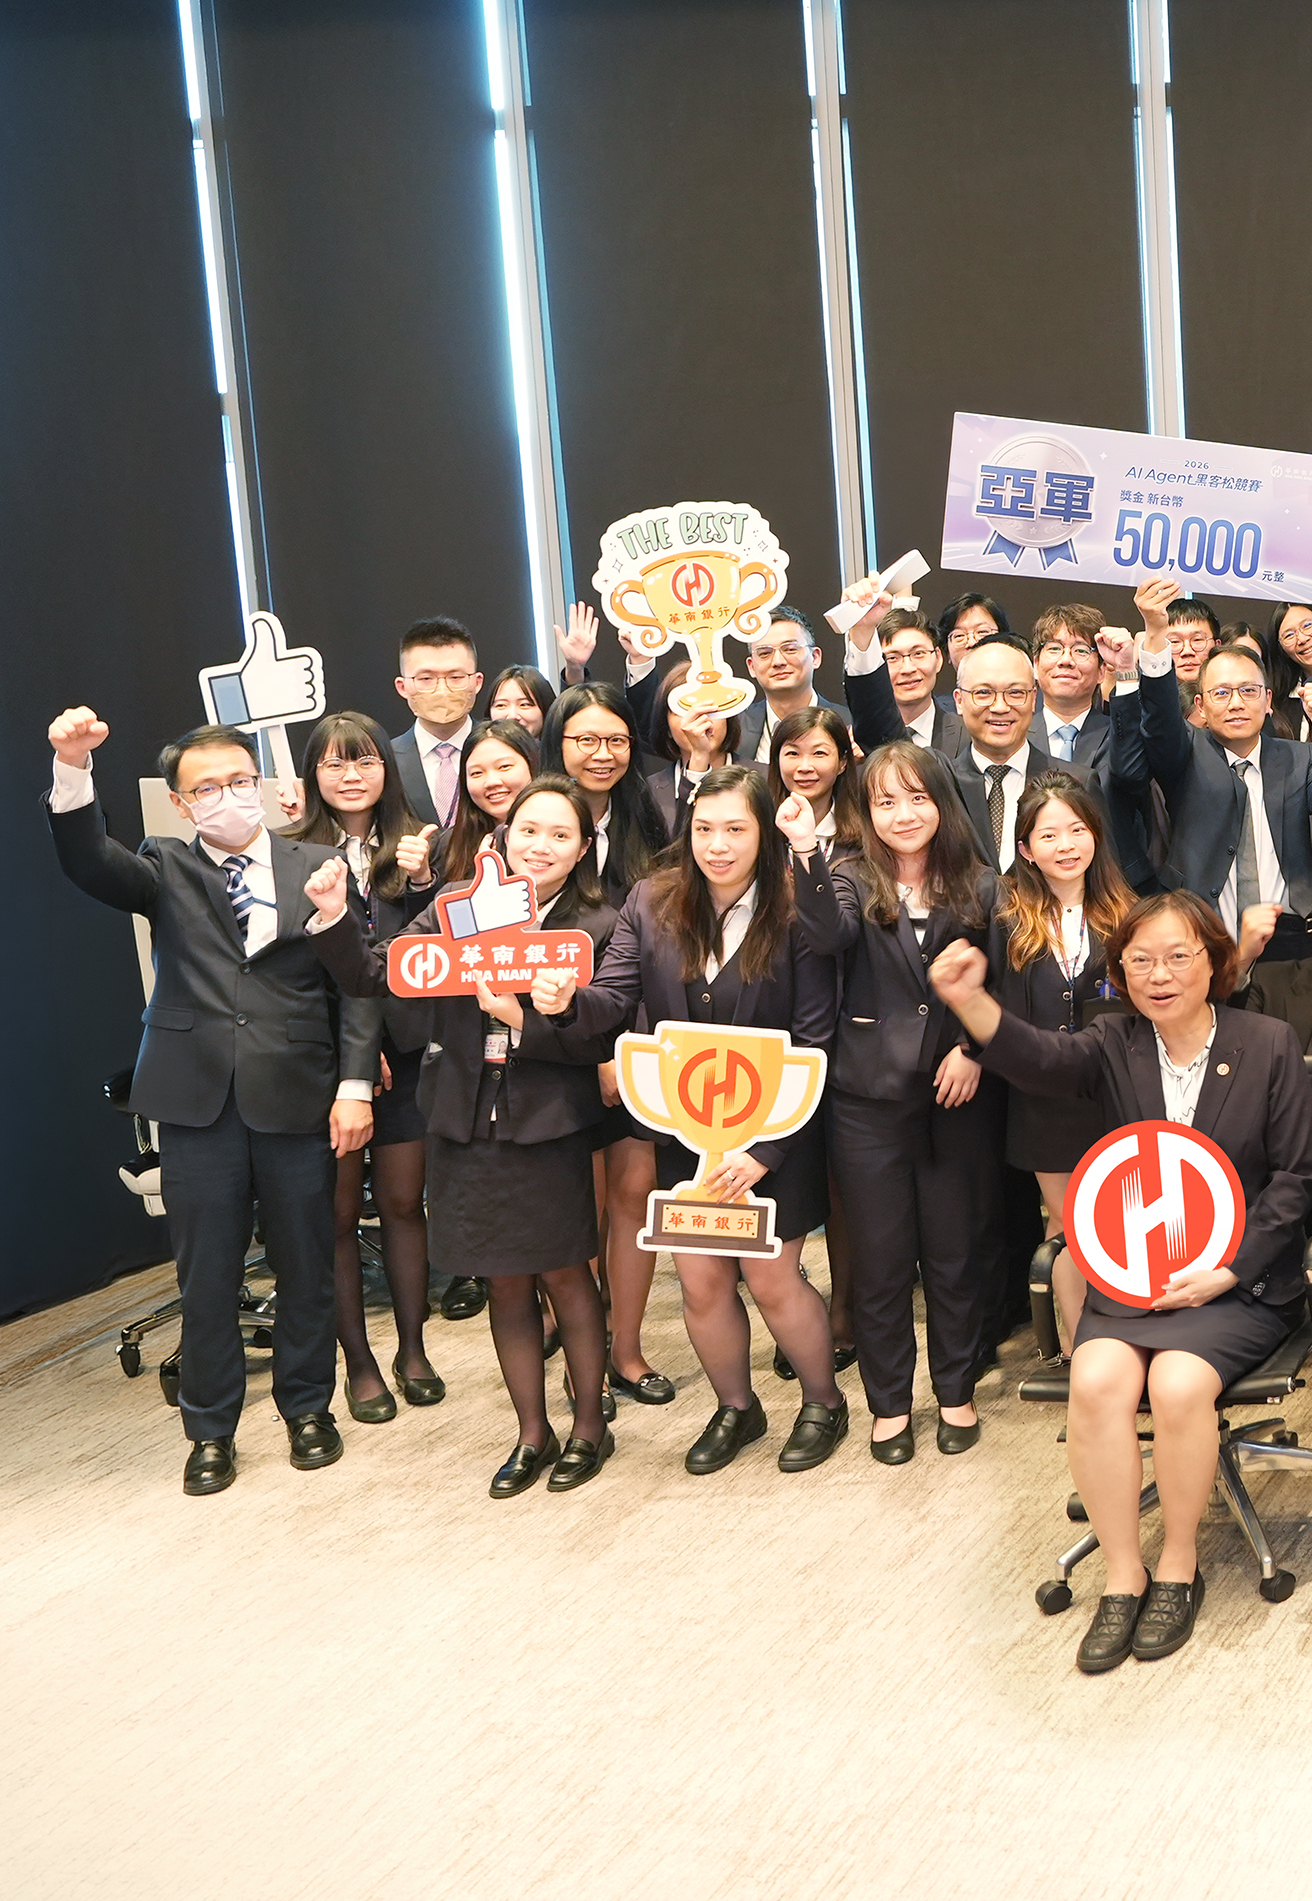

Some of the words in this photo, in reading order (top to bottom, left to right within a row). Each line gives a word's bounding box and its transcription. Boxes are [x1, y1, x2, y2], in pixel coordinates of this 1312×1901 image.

[1125, 466, 1143, 479] AI
[1184, 460, 1209, 470] 2026
[974, 463, 1095, 525] 亞軍
[1120, 489, 1144, 503] 獎金
[1146, 492, 1184, 508] 新台幣
[617, 517, 673, 560] THE
[679, 511, 748, 545] BEST
[1113, 508, 1262, 579] 50,000
[668, 606, 730, 625] 華南銀行
[459, 943, 581, 968] 華南銀行
[497, 968, 532, 981] NAN
[668, 1212, 754, 1231] 華南銀行
